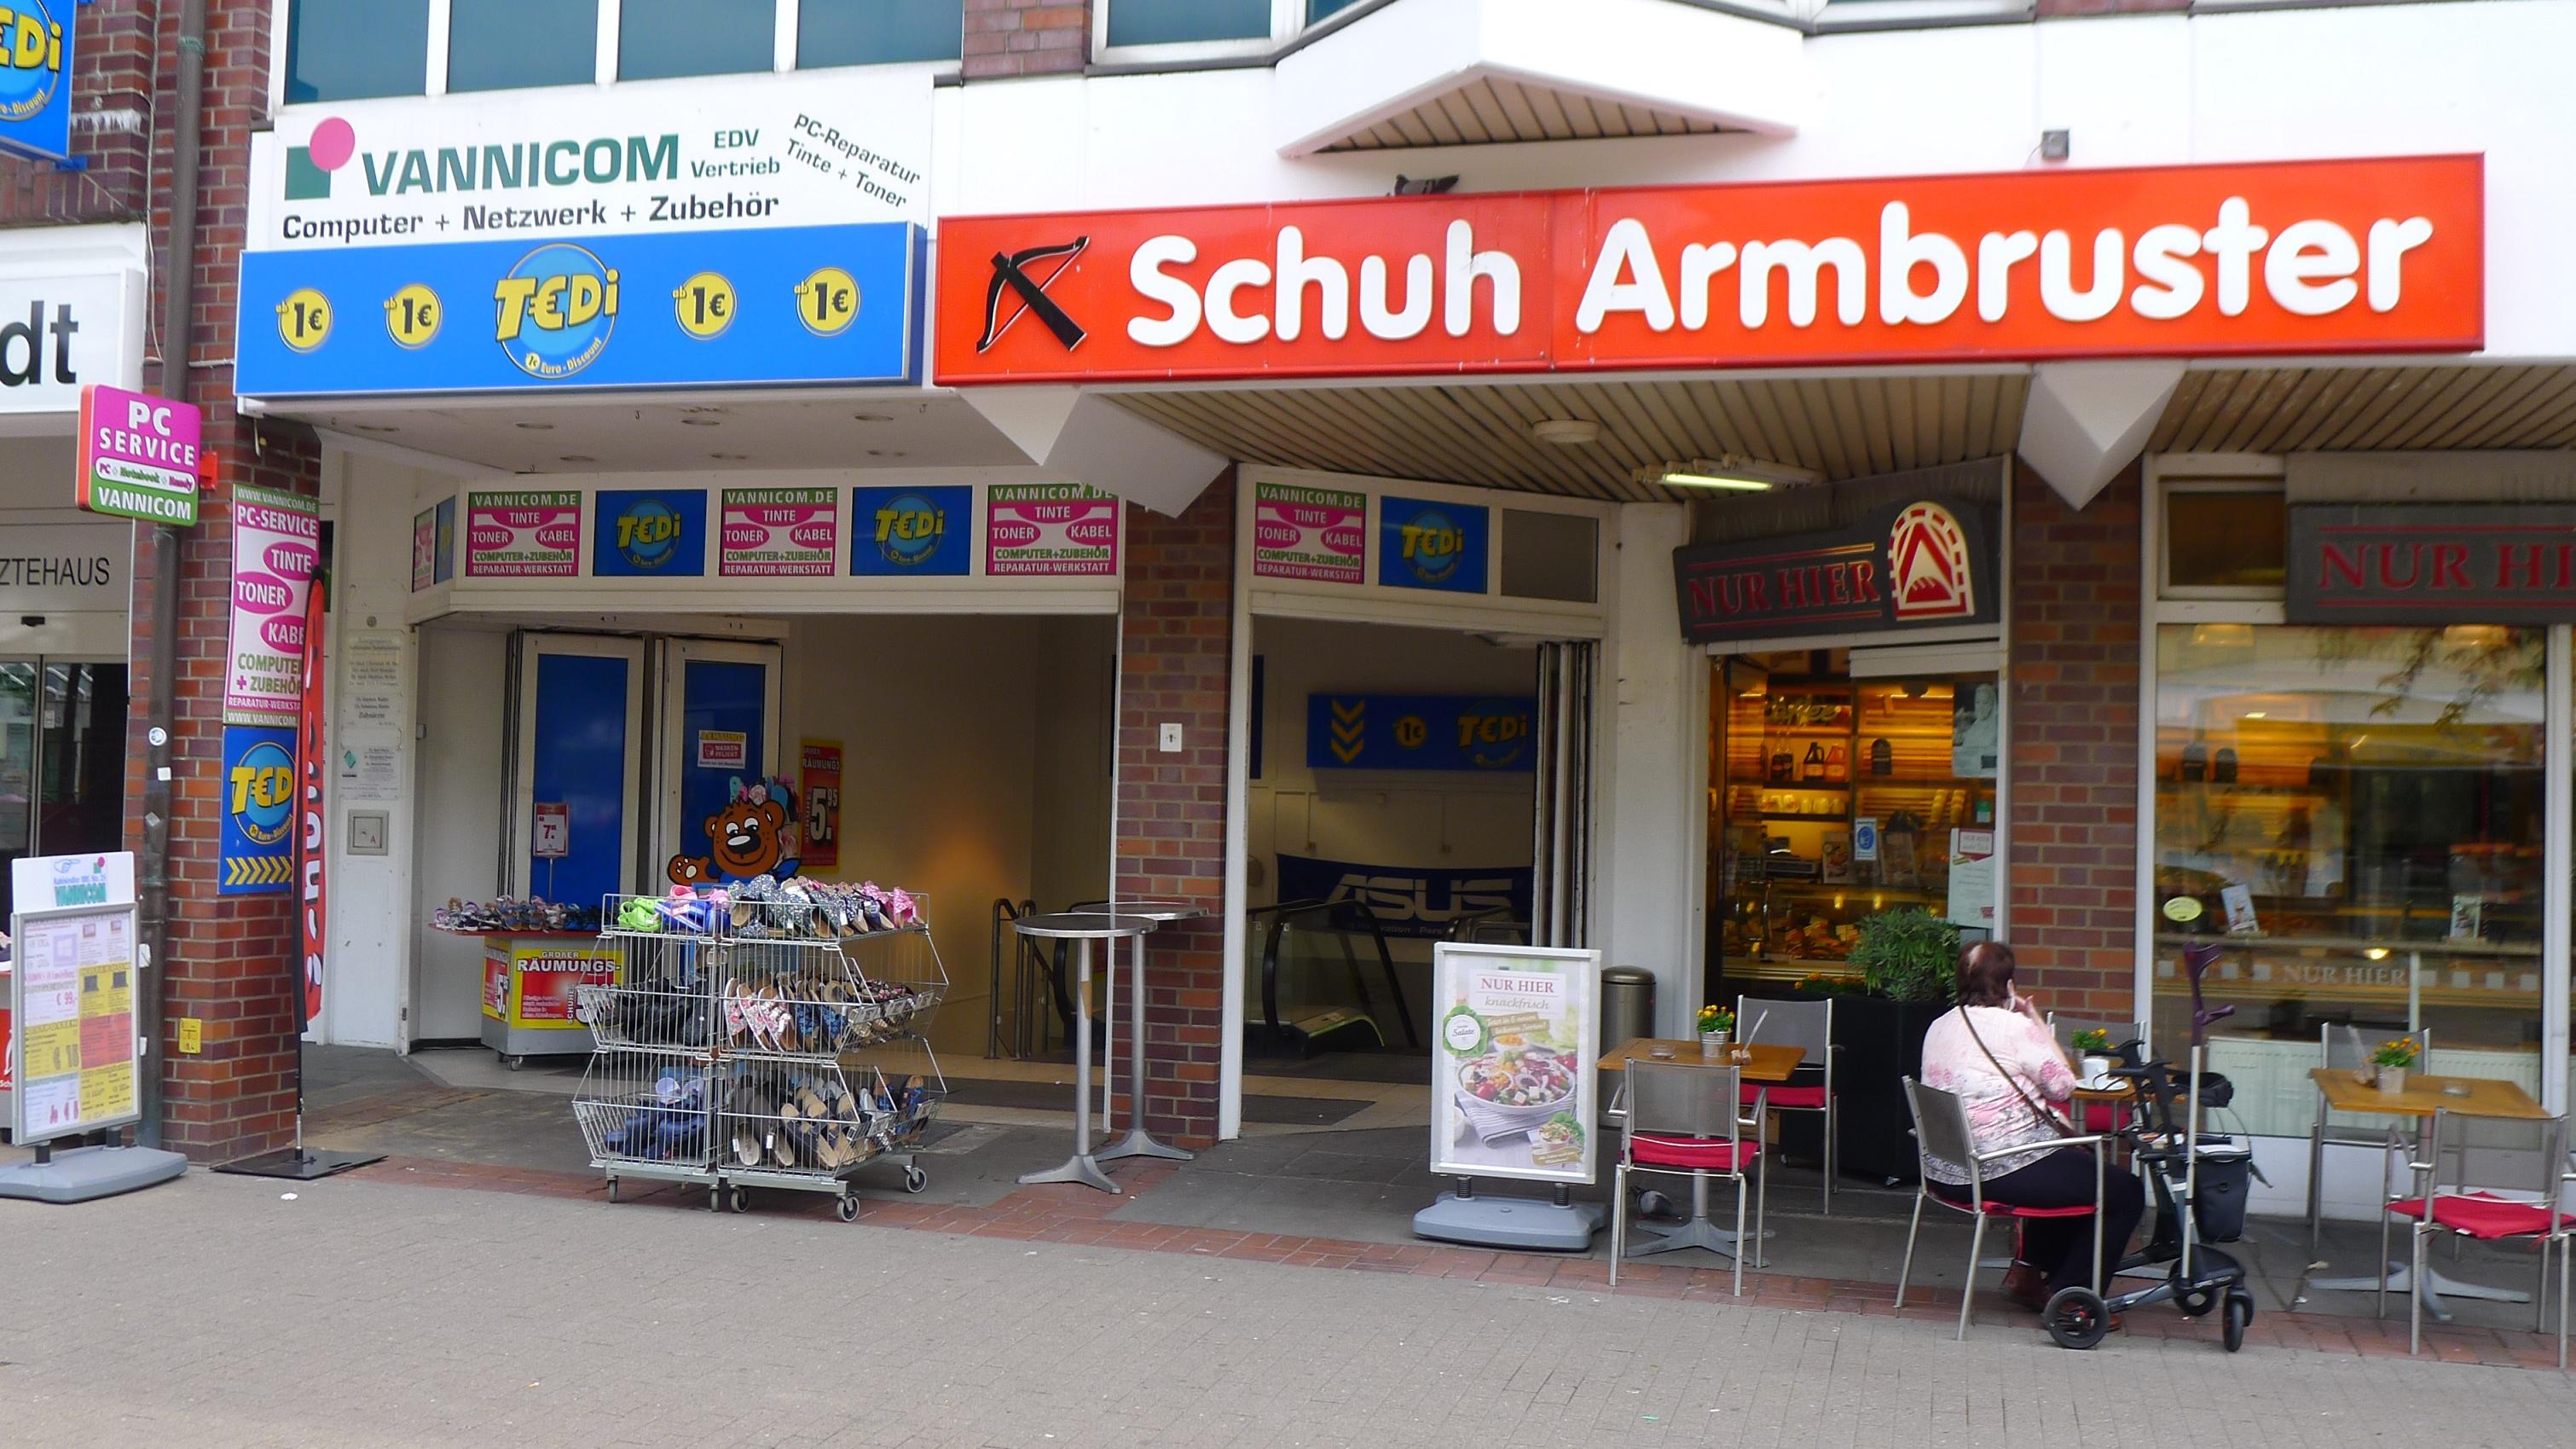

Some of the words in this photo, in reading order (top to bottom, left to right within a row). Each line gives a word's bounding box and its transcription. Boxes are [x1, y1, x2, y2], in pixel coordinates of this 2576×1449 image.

[714, 128, 760, 148] EDV
[794, 113, 921, 185] PC-Reparatur
[362, 133, 679, 196] VANNICOM
[690, 156, 781, 178] Vertrieb
[786, 137, 832, 173] Tinte
[854, 171, 907, 209] Toner
[283, 212, 424, 244] Computer
[435, 214, 450, 230] +
[462, 199, 607, 230] Netzwerk
[620, 205, 636, 222] +
[648, 190, 779, 222] Zubehör
[1126, 217, 1521, 347] Schuh
[1575, 196, 2434, 333] Armbruster
[494, 267, 622, 342] TEDi
[128, 399, 172, 437] PC
[99, 427, 195, 467] SERVICE
[98, 486, 192, 521] VANNICOM
[238, 487, 317, 513] WWW.VANNICOM.DE
[474, 492, 577, 507] VANNICOM.DE
[727, 490, 834, 504] VANNICOM.DE
[1259, 486, 1362, 509] VANNICOM.DE
[237, 504, 318, 537] PC-SERVICE
[509, 512, 541, 525] TINTE
[763, 510, 796, 522] TINTE
[1035, 506, 1071, 519] TINTE
[1294, 508, 1328, 525] TINTE
[472, 530, 509, 544] TONER
[540, 529, 576, 542] KABEL
[616, 513, 683, 549] TEDi
[725, 529, 764, 543] TONER
[794, 527, 833, 541] KABEL
[874, 508, 945, 544] TEDi
[993, 526, 1035, 540] TONER
[1070, 525, 1112, 538] KABEL
[1257, 525, 1298, 542] TONER
[1325, 531, 1363, 548] KABEL
[1400, 525, 1465, 559] TEDi
[271, 548, 312, 573] TINTE
[473, 565, 573, 575] REPARATUR-WERKSTATT
[725, 565, 831, 575] REPARATUR-WERKSTATT
[994, 562, 1109, 572] REPARATUR-WERKSTATT
[2317, 541, 2475, 591] NUR
[2491, 542, 2576, 590] HI
[1256, 563, 1360, 581] REPARATUR-WERKSTATT
[236, 580, 287, 607] TONER
[1687, 571, 1772, 618] NUR
[1776, 559, 1881, 609] HIER
[268, 622, 304, 646] KABE
[230, 765, 294, 814] TED
[1324, 872, 1514, 923] ASUS
[517, 957, 622, 972] RÄUMUNGS-
[2284, 964, 2336, 984] NUR
[2343, 966, 2408, 987] HIER
[1481, 977, 1513, 992] NUR
[1518, 980, 1554, 994] HIER
[1484, 995, 1549, 1011] knackfrisch
